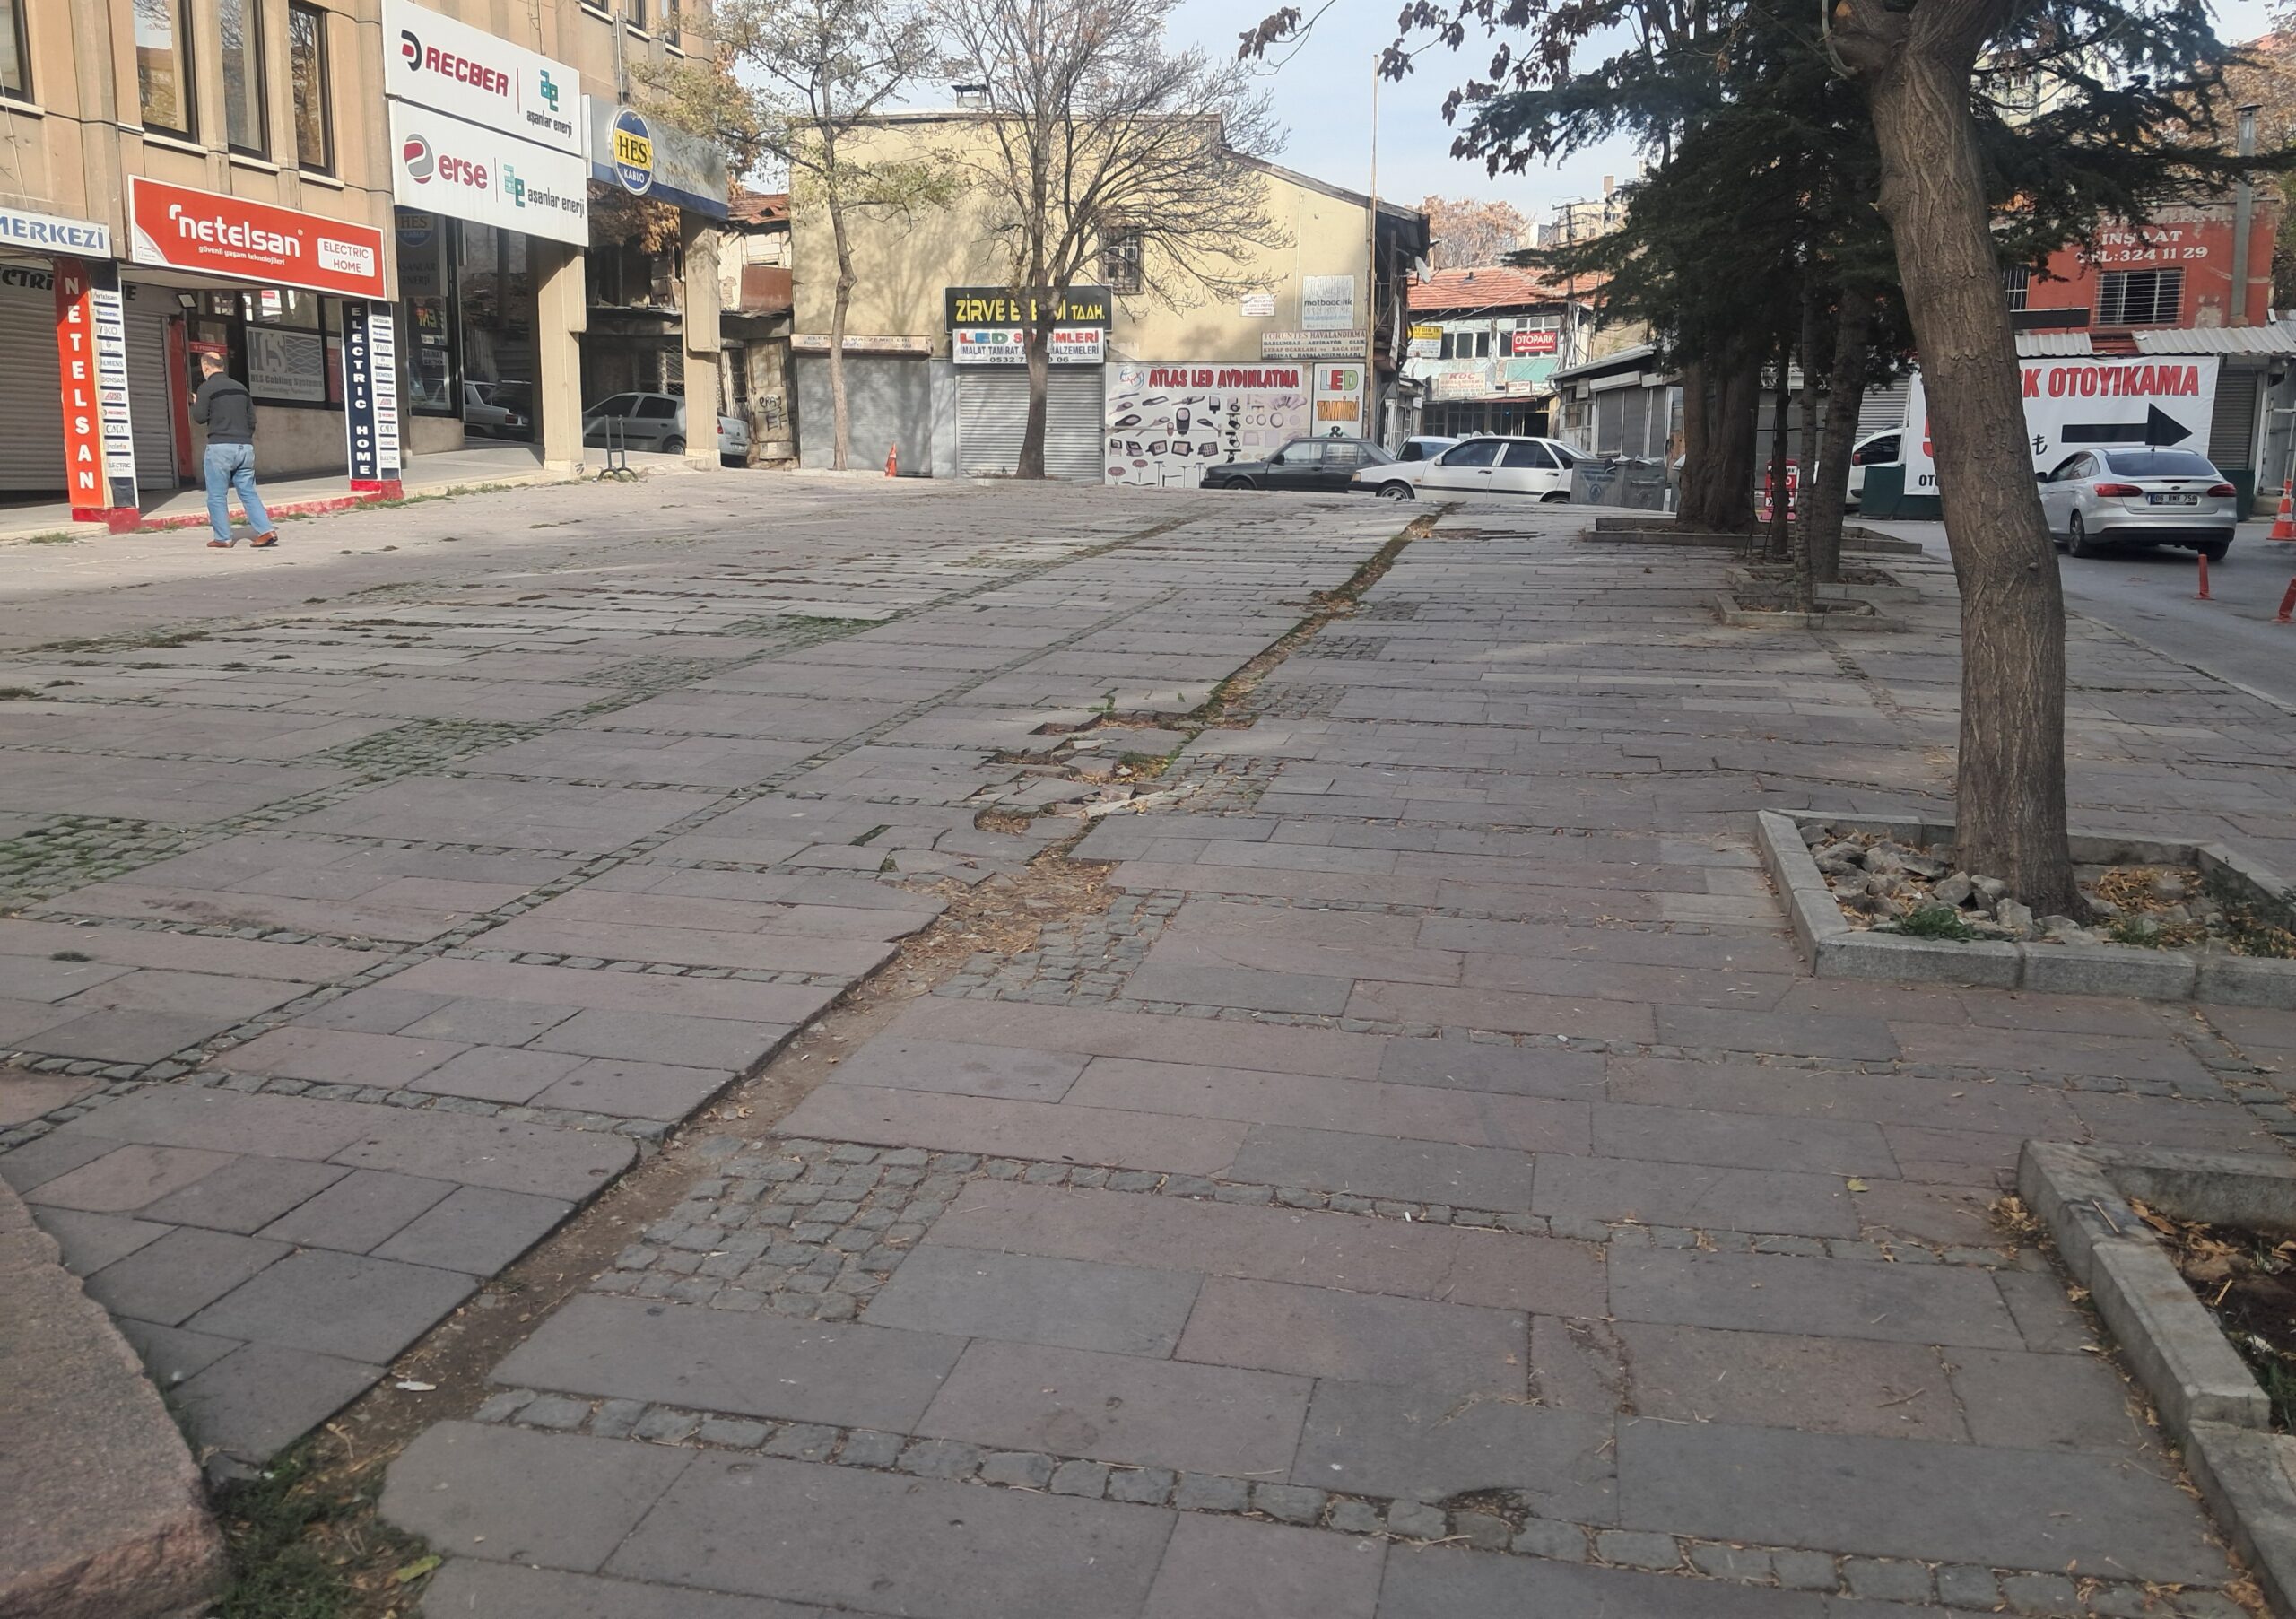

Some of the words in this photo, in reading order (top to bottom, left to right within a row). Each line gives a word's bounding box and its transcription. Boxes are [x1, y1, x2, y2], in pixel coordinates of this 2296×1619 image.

[426, 46, 509, 97] RECBER
[526, 110, 552, 129] aşanlar
[619, 135, 648, 164] HES
[439, 154, 488, 190] erse
[623, 169, 646, 184] KABLO
[527, 187, 561, 207] aşanlar
[561, 196, 585, 218] enerji
[178, 215, 300, 257] netelsan
[324, 241, 370, 259] ELECTRIC
[2162, 248, 2178, 260] 11
[2183, 246, 2209, 259] 29
[333, 258, 361, 274] HOME
[955, 292, 1006, 322] ZİRVE
[960, 332, 1009, 344] LED
[960, 344, 987, 355] İMALAT
[987, 344, 1019, 355] TAMİRAT
[1515, 334, 1555, 345] OTOPARK
[351, 307, 367, 409] ELECTRIC
[65, 277, 94, 490] NETELSAN
[1149, 369, 1187, 388] ATLAS
[1191, 369, 1214, 388] LED
[1217, 369, 1300, 388] AYDINLATMA
[1319, 369, 1359, 391] LED
[2048, 366, 2200, 398] OTOYIKAMA
[1316, 396, 1360, 422] TAMİRİ
[356, 426, 371, 474] HOME
